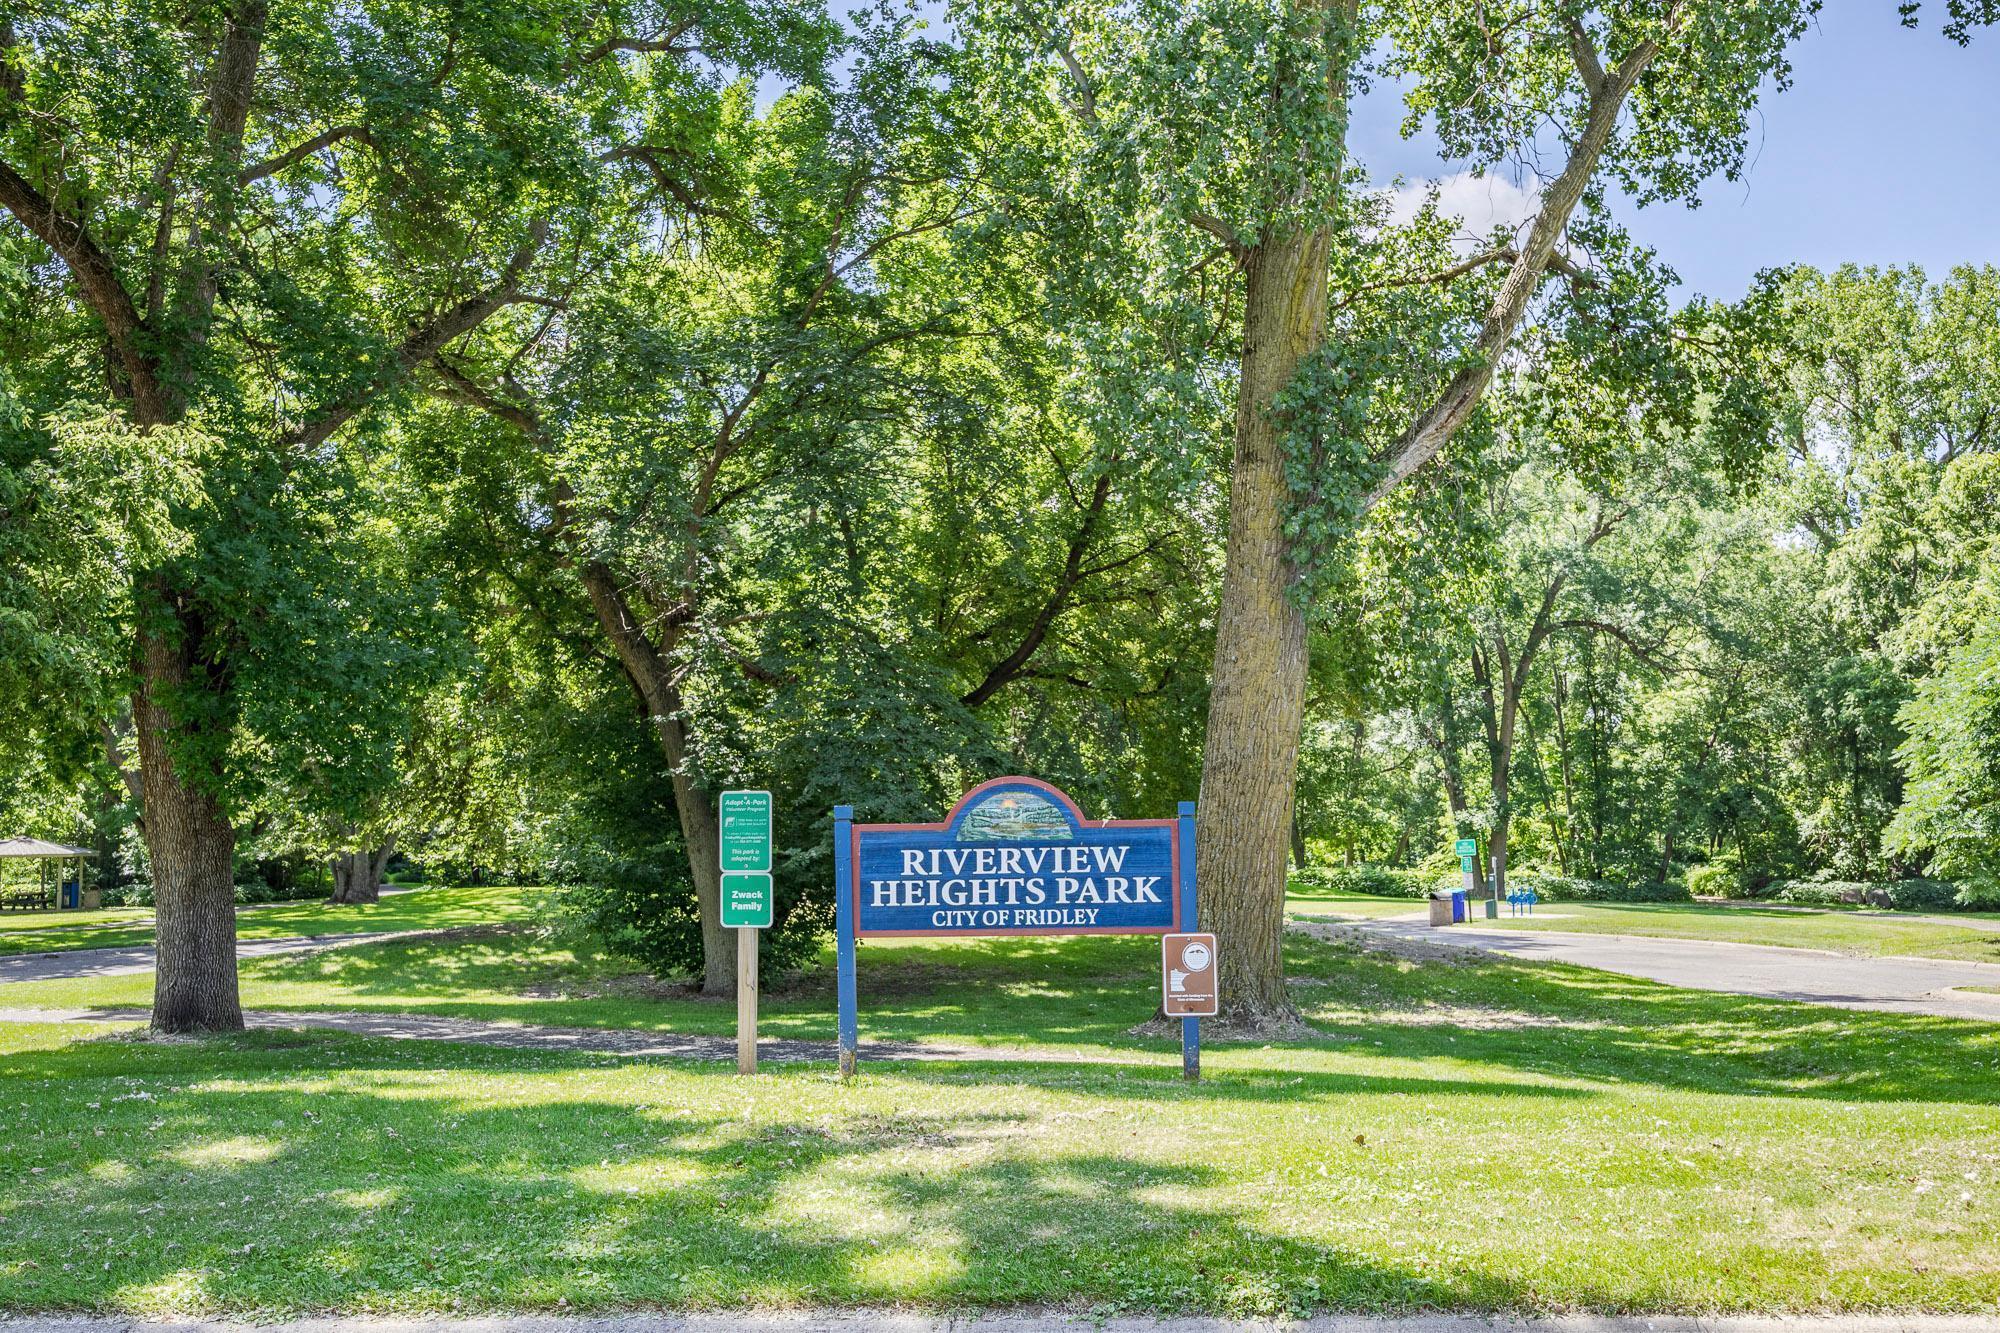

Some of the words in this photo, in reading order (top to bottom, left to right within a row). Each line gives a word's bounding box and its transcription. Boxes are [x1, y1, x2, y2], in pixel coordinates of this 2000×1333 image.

[900, 845, 1130, 876] RIVERVIEW
[731, 890, 763, 899] Zwack
[870, 877, 1046, 907] HEIGHTS
[1055, 876, 1162, 905] PARK
[731, 902, 762, 911] Family
[932, 910, 980, 927] CITY
[981, 909, 1009, 926] OF
[1014, 908, 1100, 926] FRIDLEY
